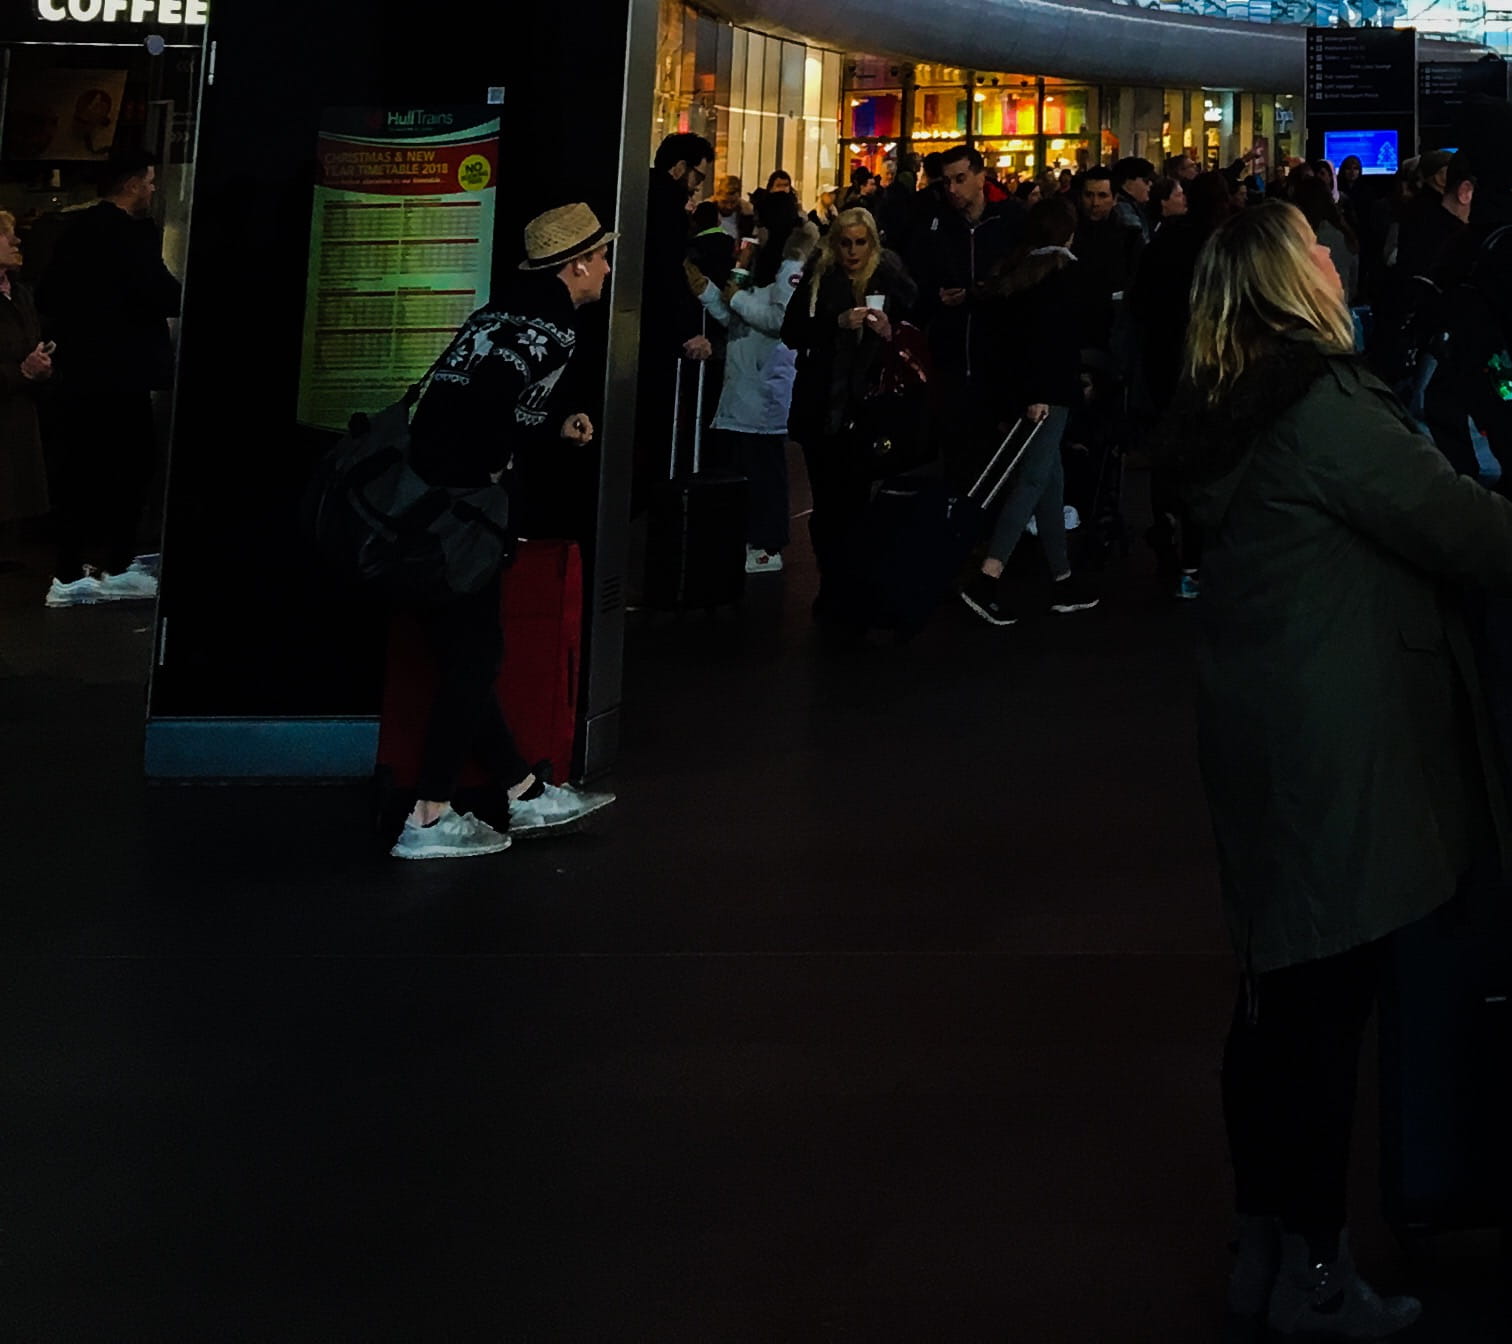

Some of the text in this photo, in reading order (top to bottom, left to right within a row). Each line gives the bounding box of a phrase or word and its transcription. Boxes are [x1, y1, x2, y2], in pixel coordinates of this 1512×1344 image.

[323, 150, 437, 162] CHRISTMAS & NEW
[323, 162, 449, 176] YEAR TIMETABLE 2018
[465, 161, 483, 173] NO
